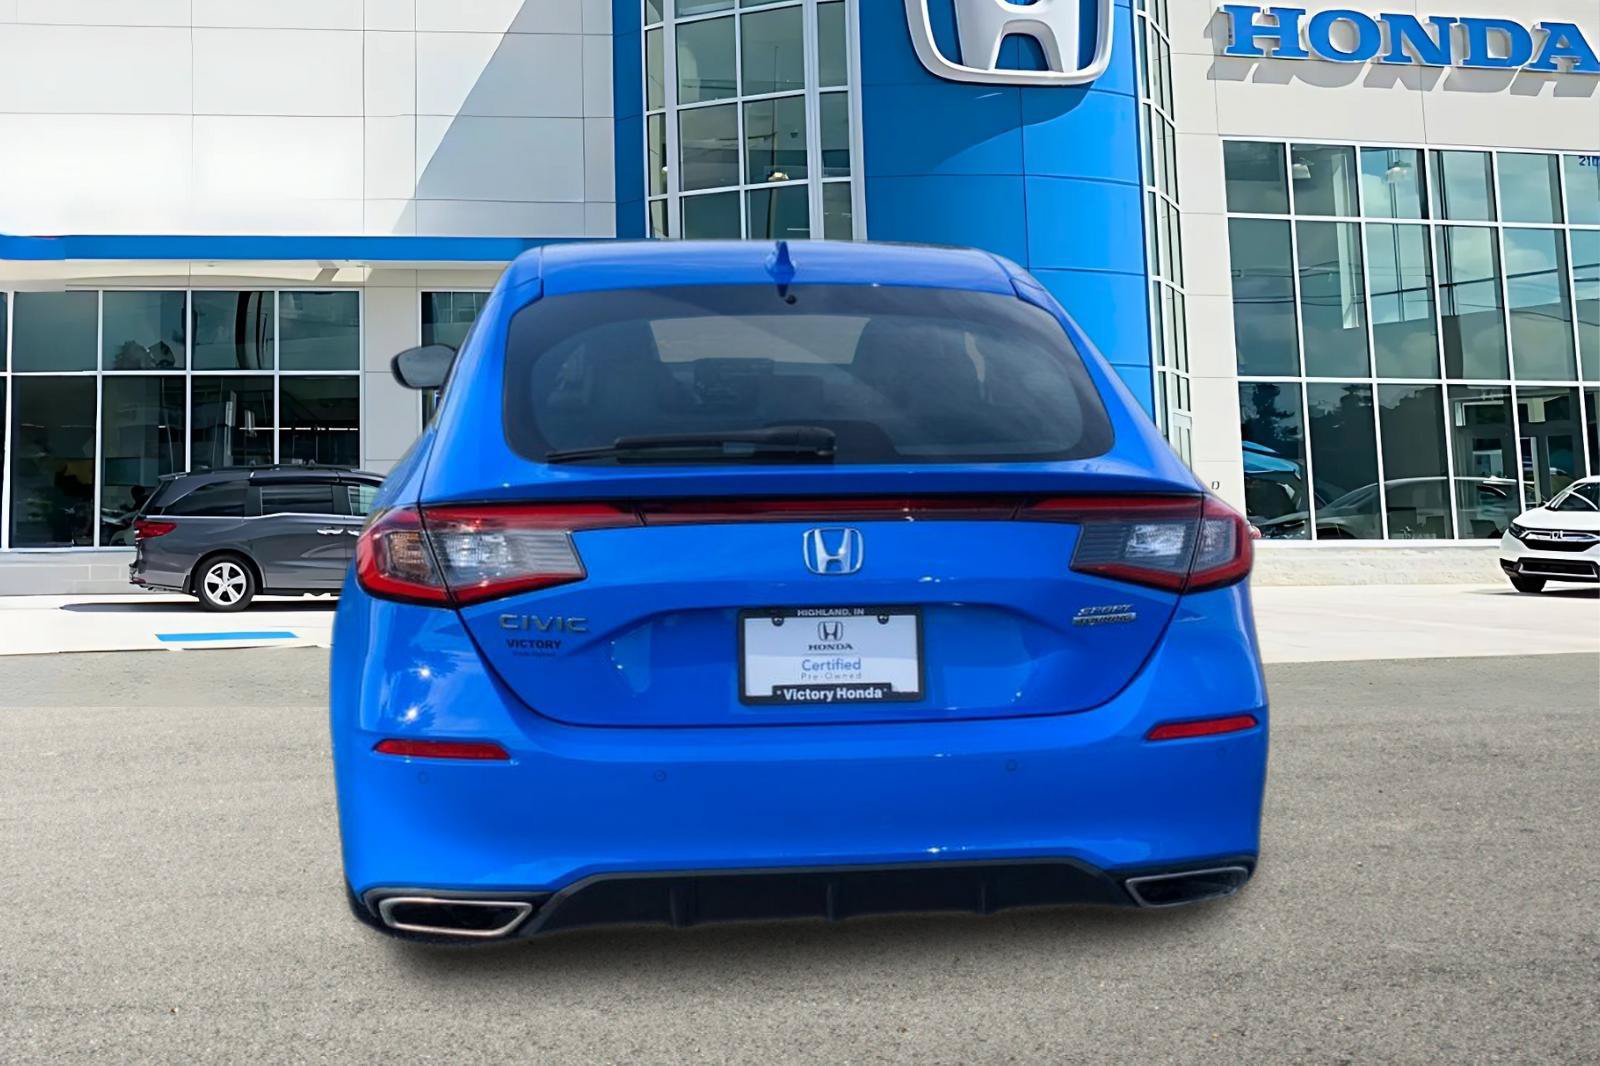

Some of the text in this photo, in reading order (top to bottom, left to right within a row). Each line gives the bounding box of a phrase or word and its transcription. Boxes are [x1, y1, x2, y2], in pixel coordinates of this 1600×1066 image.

[1223, 4, 1599, 73] HONDA
[853, 608, 865, 616] IN
[499, 613, 588, 632] CIVIC
[506, 640, 562, 649] VICTORY
[808, 643, 854, 651] HONDA
[801, 658, 862, 672] Certified
[801, 672, 863, 681] Pre-Owned
[783, 687, 883, 702] Victory Honda
